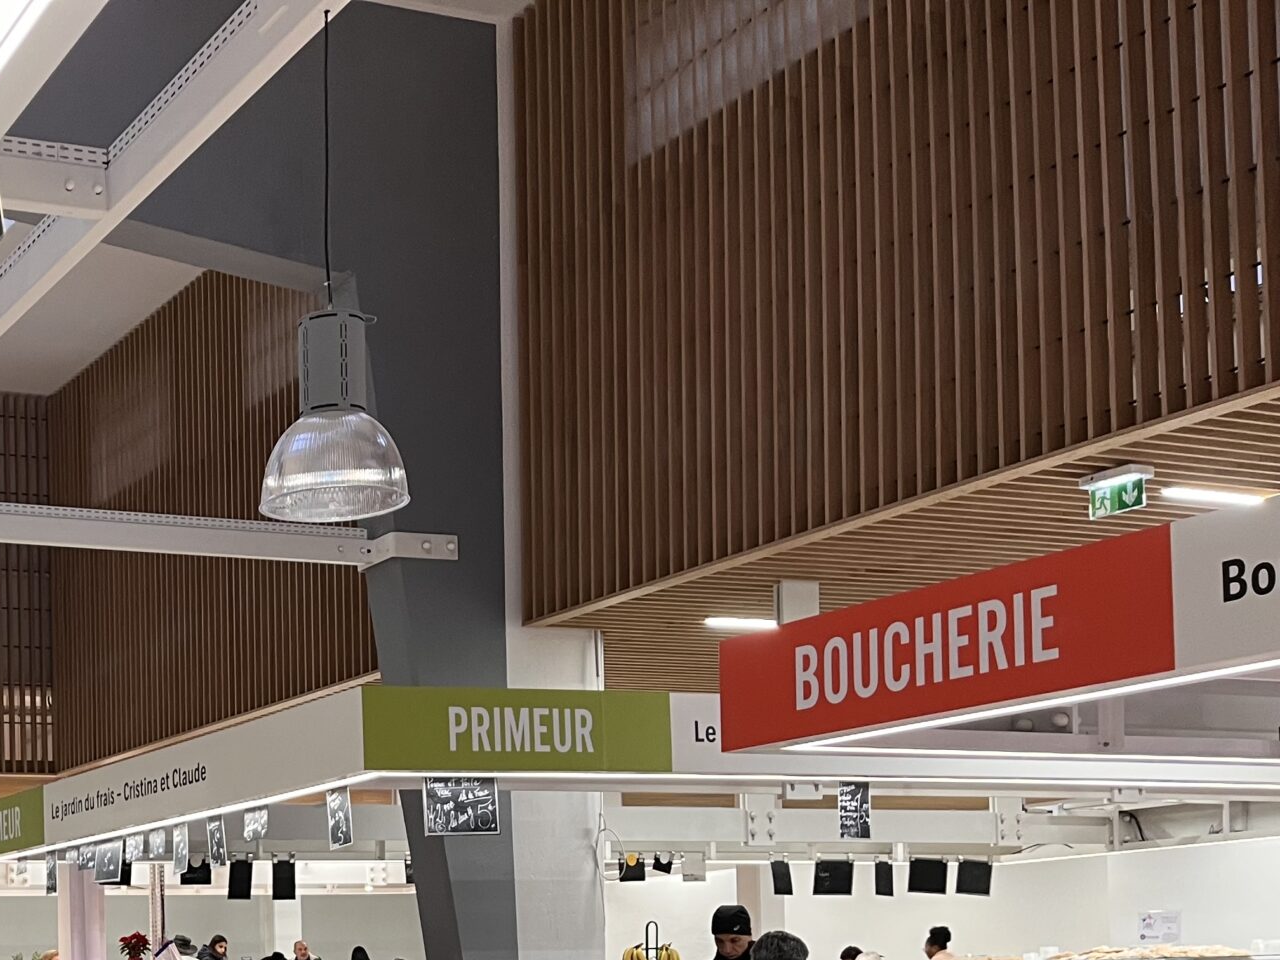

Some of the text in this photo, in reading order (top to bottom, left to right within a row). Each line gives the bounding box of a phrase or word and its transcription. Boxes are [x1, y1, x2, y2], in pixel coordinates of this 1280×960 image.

[1222, 558, 1276, 604] Bo
[795, 584, 1060, 711] BOUCHERIE
[448, 705, 595, 753] PRIMEUR
[694, 720, 717, 743] Le
[51, 802, 60, 820] Le
[61, 796, 83, 821] jardin
[84, 793, 95, 811] du
[96, 787, 115, 809] frais
[123, 777, 158, 801] Cristina
[160, 772, 170, 792] et
[172, 762, 207, 789] Claude
